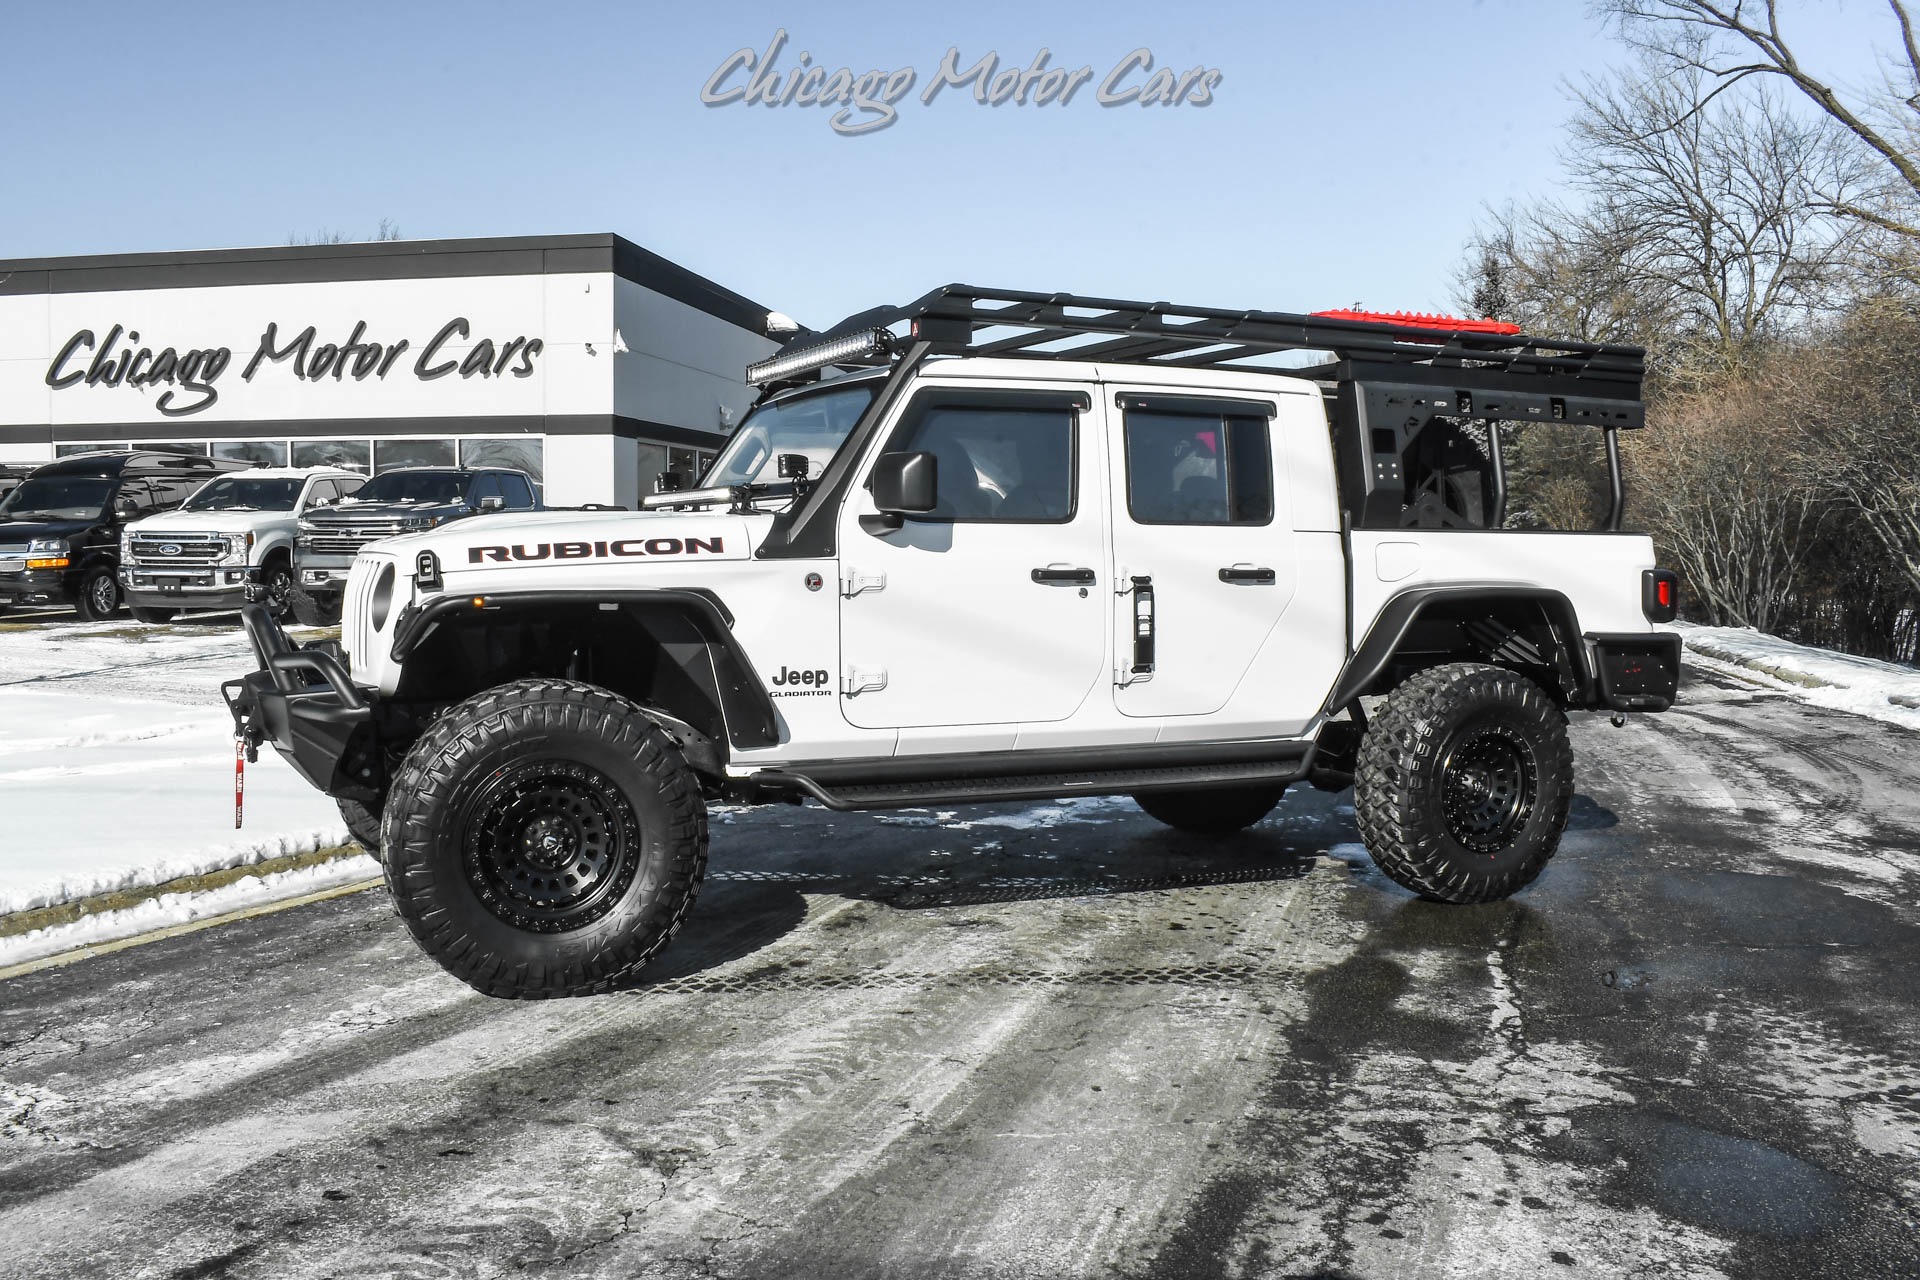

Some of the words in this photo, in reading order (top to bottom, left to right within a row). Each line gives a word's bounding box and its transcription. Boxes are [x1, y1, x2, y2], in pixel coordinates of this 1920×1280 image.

[45, 323, 232, 416] Chicago
[241, 320, 410, 382] Motor
[413, 317, 544, 380] Cars
[468, 537, 724, 564] RUBICON
[772, 666, 829, 688] Jeep
